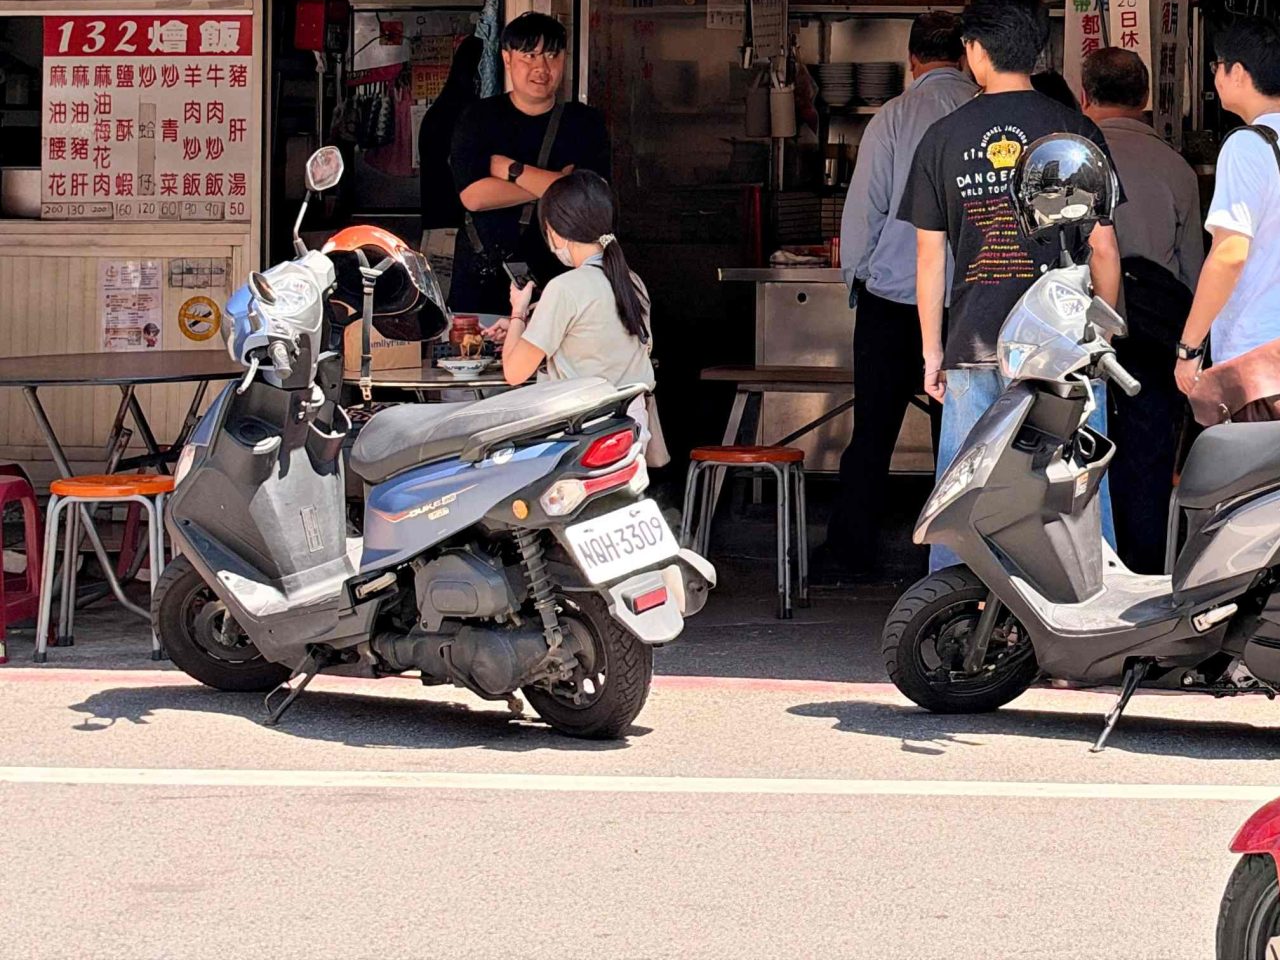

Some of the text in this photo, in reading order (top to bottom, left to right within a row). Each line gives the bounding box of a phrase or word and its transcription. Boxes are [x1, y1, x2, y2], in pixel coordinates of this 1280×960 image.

[49, 64, 67, 196] 麻油腰花
[71, 64, 89, 196] 麻油豬肝
[93, 64, 112, 196] 麻油梅花肉
[115, 64, 134, 196] 鹽酥蝦
[160, 64, 180, 196] 炒青菜
[183, 64, 202, 196] 羊肉炒飯
[205, 64, 224, 196] 牛肉炒飯
[228, 64, 247, 196] 豬肝湯
[67, 203, 84, 216] 130
[115, 203, 132, 216] 160
[138, 202, 155, 215] 120
[161, 201, 177, 216] 60
[184, 202, 197, 216] 90
[205, 202, 219, 216] 90
[230, 202, 245, 215] 50
[578, 516, 664, 570] NQH-3309
